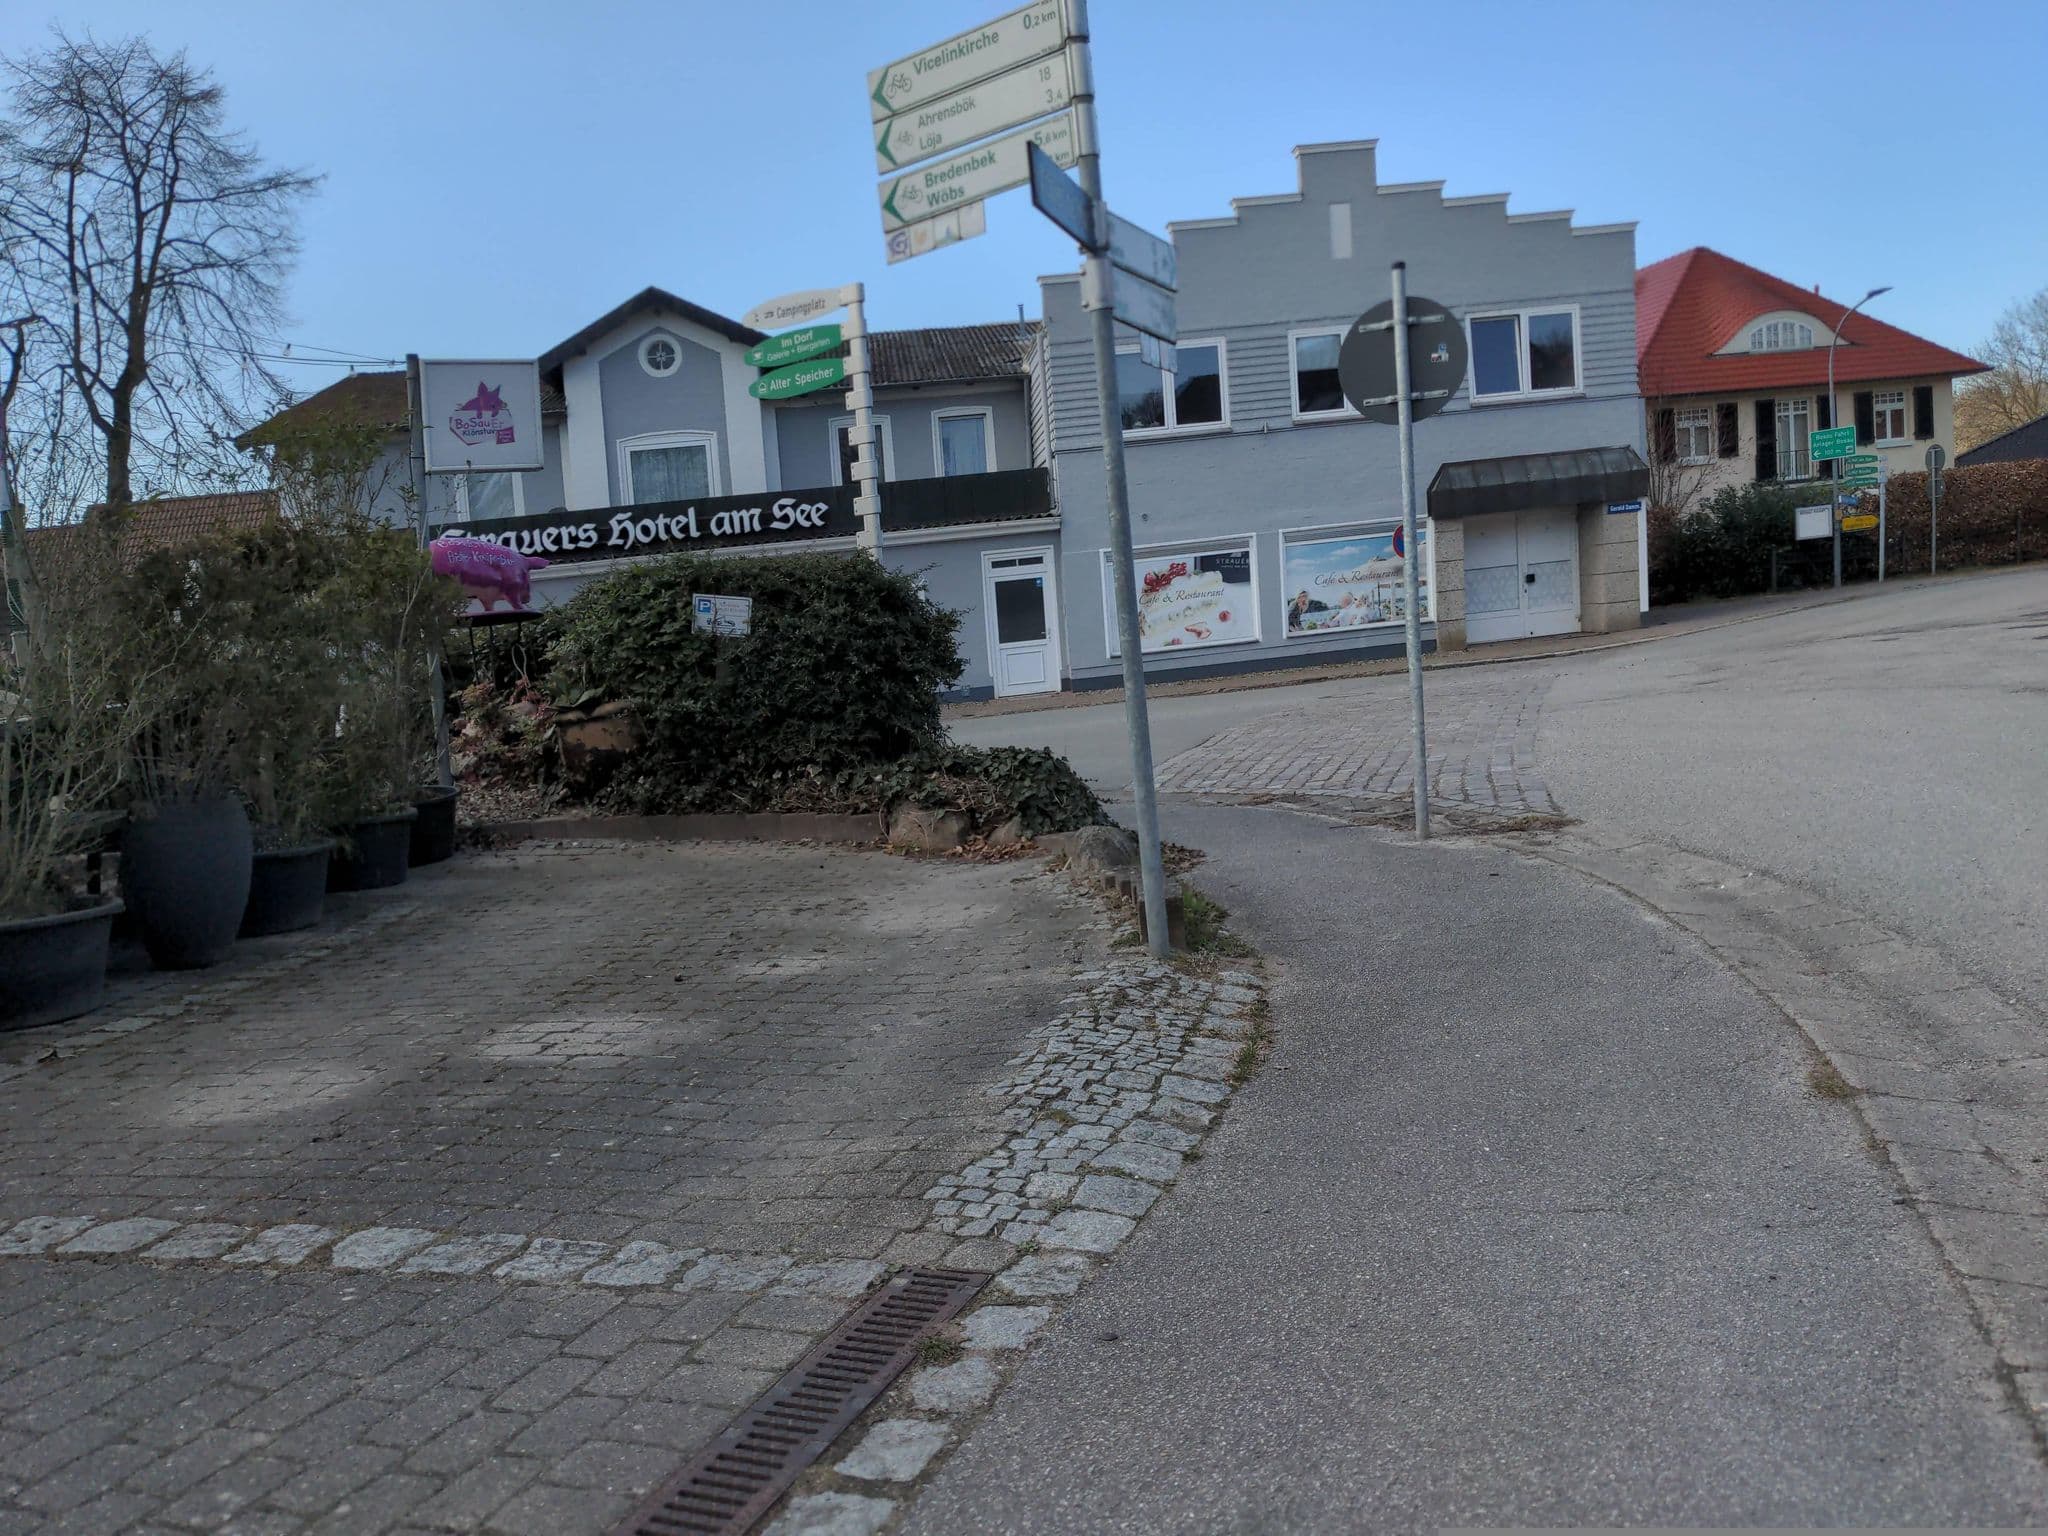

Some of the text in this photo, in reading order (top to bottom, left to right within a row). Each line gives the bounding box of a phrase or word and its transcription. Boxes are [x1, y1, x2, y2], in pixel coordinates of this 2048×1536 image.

[913, 11, 1056, 75] Vicelinkirche 0,2 km
[918, 66, 1051, 128] Ahrensbök 18
[924, 150, 996, 188] Bredenbek
[776, 299, 826, 319] Campingplatz
[794, 330, 813, 343] Dorf
[770, 367, 834, 391] Alter Speicher
[439, 523, 599, 555] auers
[608, 507, 701, 549] Hotel
[710, 508, 763, 536] am
[770, 498, 829, 530] See
[1351, 569, 1400, 582] Restaurant
[1175, 588, 1224, 602] Restaurant
